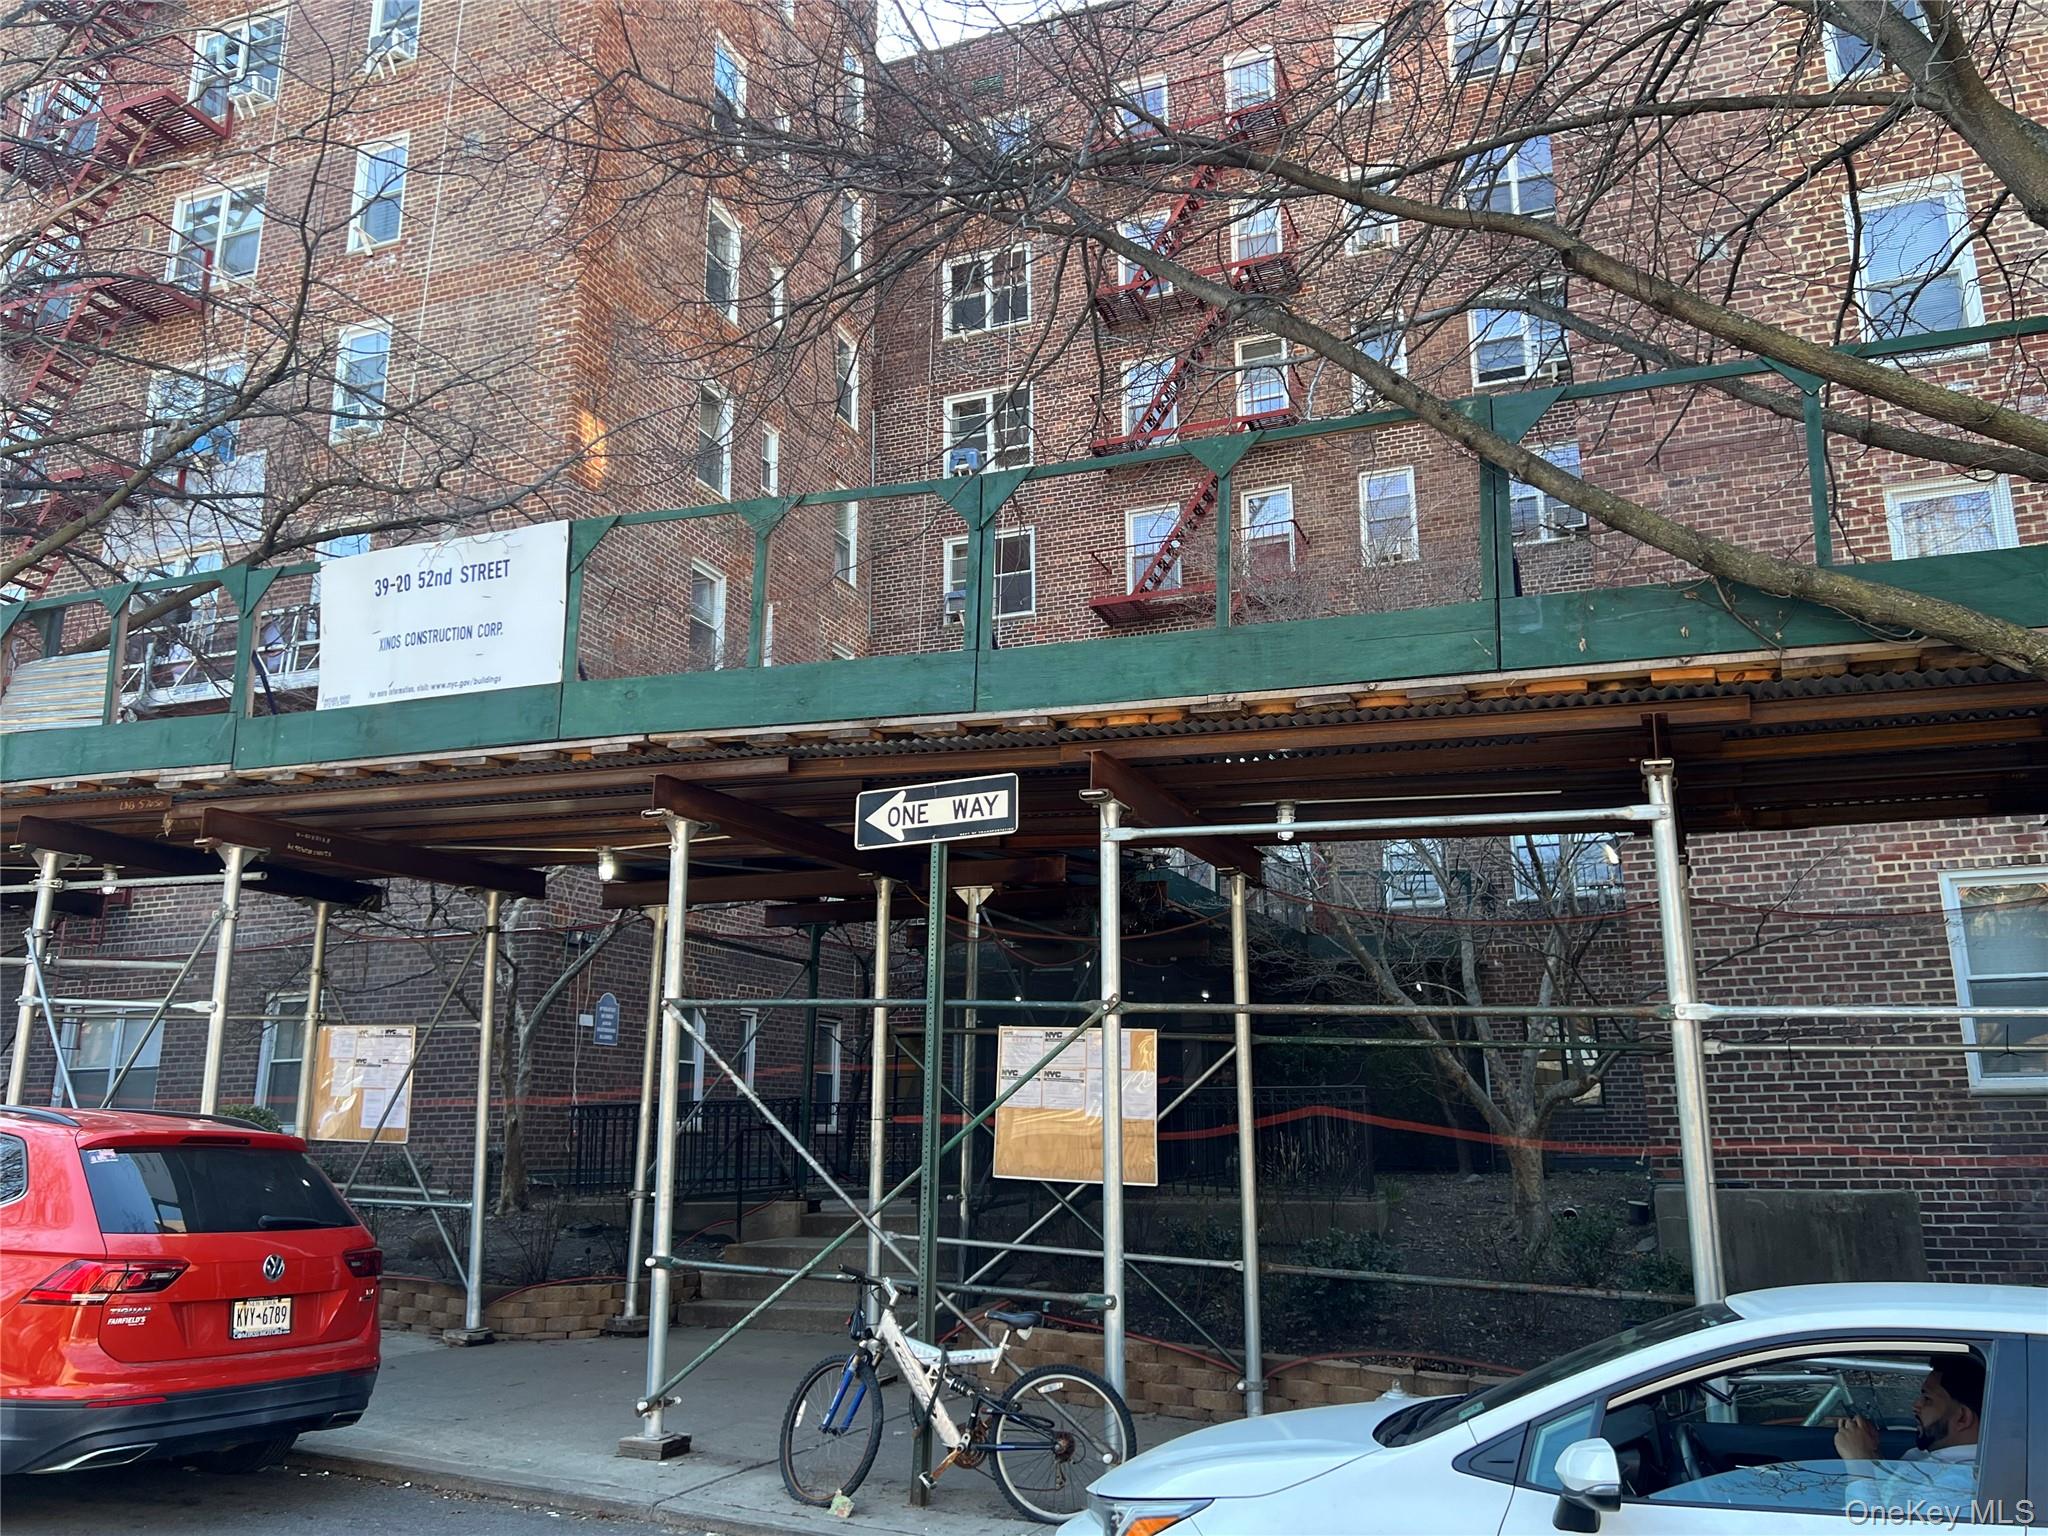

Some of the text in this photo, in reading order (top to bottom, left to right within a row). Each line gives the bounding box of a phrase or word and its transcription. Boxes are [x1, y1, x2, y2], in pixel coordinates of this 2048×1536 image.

[375, 559, 511, 597] 39-20 52nd STREET
[405, 625, 473, 647] CONSTRUCTION
[477, 621, 503, 638] CORP.
[431, 675, 501, 690] www.nyc.gov/buildings
[887, 794, 999, 827] ONE WAY
